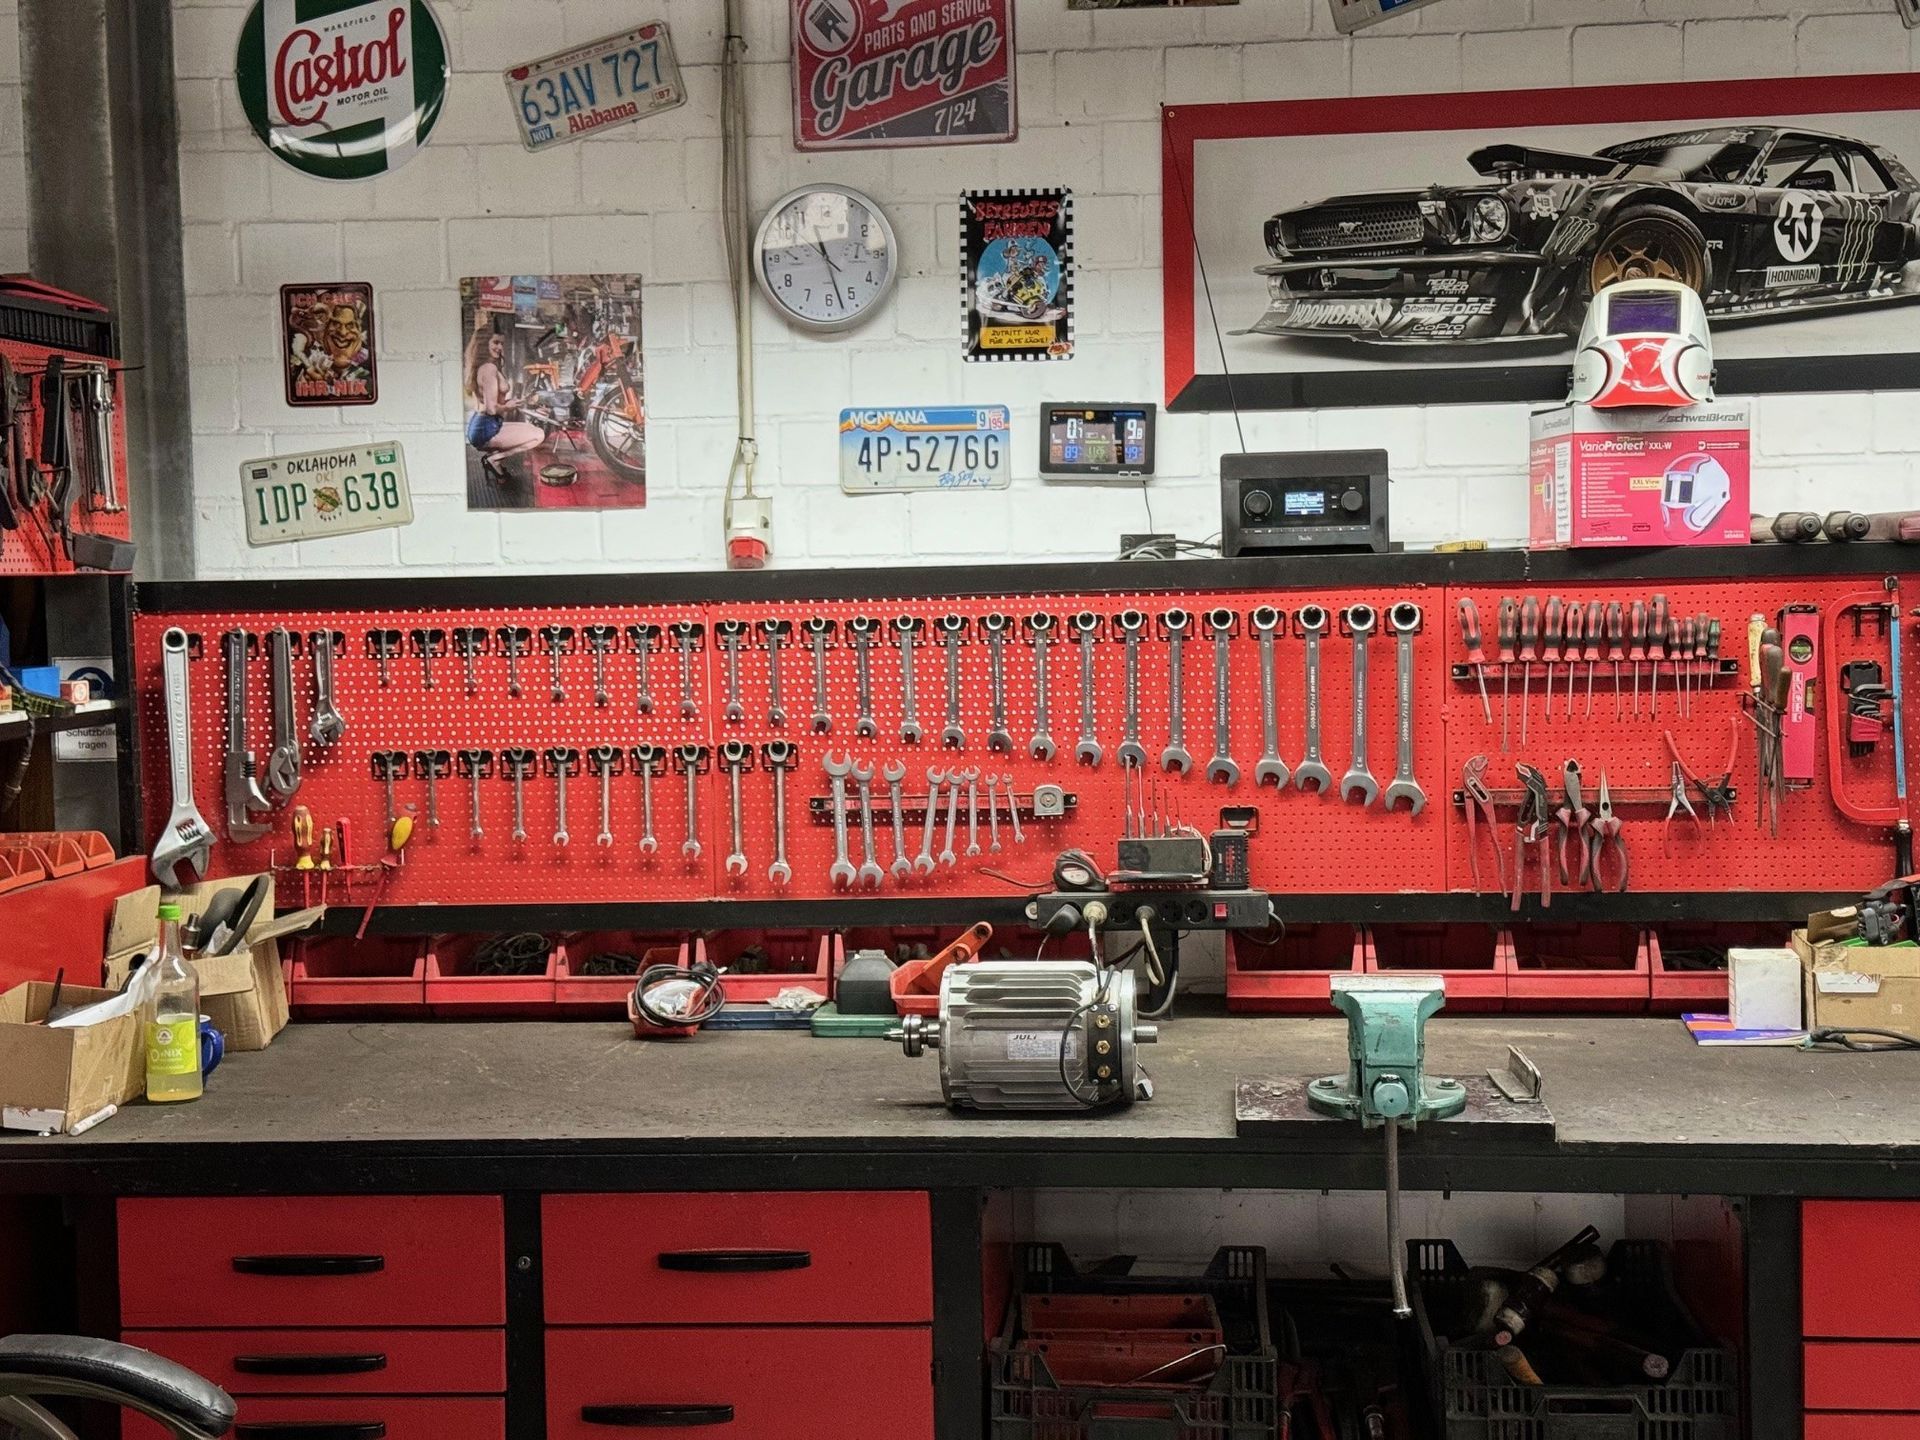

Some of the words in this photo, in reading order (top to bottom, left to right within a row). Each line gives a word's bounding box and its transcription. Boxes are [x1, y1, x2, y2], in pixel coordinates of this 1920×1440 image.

[323, 14, 376, 33] WAKEFIELD
[864, 20, 905, 54] PARTS
[910, 10, 937, 39] AND
[274, 7, 407, 125] Castrol
[520, 62, 597, 126] 63AV
[601, 41, 662, 98] 727
[812, 18, 1000, 136] Garage
[336, 91, 370, 107] MOTOR
[372, 86, 389, 98] OIL
[567, 100, 639, 134] Alabama
[532, 126, 551, 144] NOV
[1707, 194, 1738, 207] Ford
[861, 224, 869, 238] 2
[774, 254, 780, 263] 9
[873, 250, 880, 259] 3
[784, 273, 792, 288] 8
[865, 271, 873, 284] 4
[804, 288, 811, 302] 7
[825, 294, 833, 307] 6
[848, 287, 855, 300] 5
[1440, 303, 1495, 316] EDGE
[1412, 323, 1466, 332] GoPro
[1648, 441, 1673, 450] XXL-W
[287, 452, 357, 475] OKLAHOMA
[255, 482, 308, 526] IDP
[343, 471, 400, 513] 638
[78, 740, 107, 751] tragen
